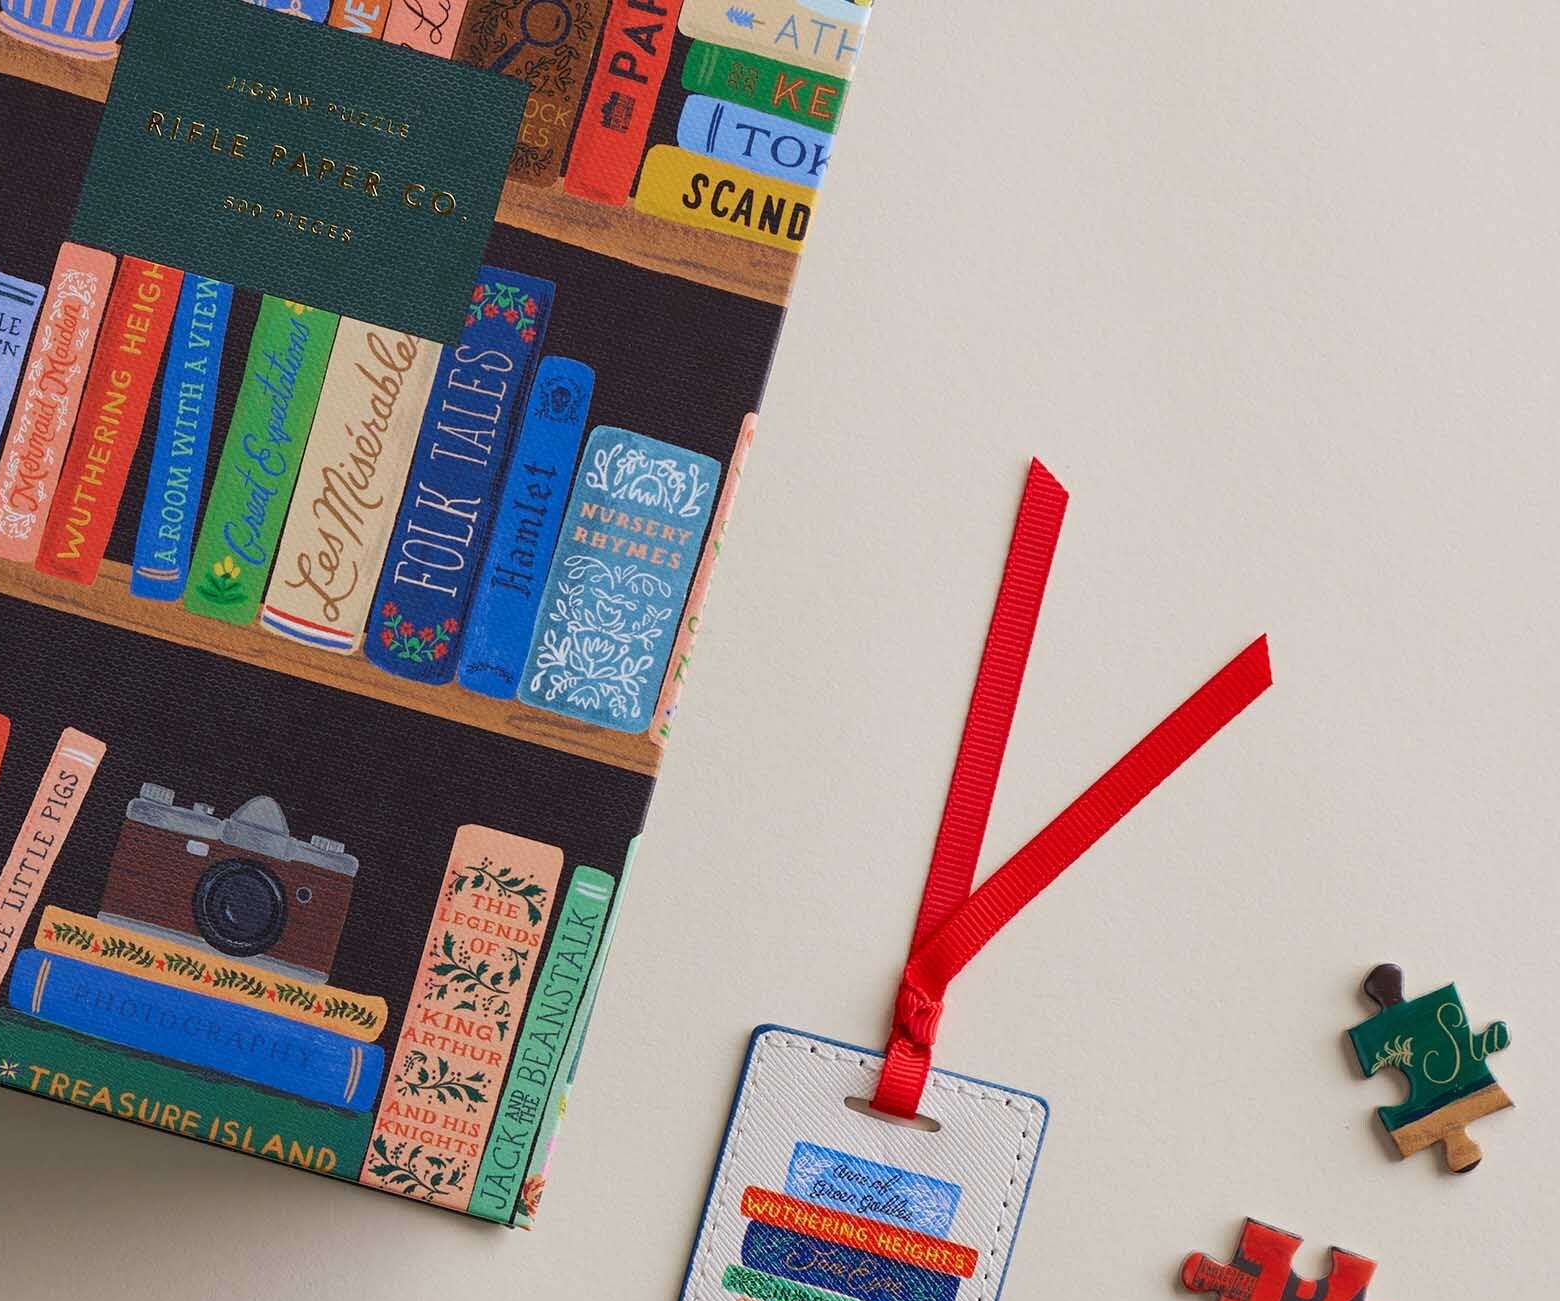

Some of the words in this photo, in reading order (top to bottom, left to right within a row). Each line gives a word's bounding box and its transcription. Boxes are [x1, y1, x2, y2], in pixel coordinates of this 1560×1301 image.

[226, 75, 313, 112] JIGSAW
[327, 103, 410, 139] PUZZLE
[772, 72, 837, 120] KE
[147, 110, 249, 158] RIFLE
[270, 144, 382, 198] PAPER
[403, 183, 469, 225] CO.
[222, 196, 263, 218] 500
[274, 208, 352, 242] PIECES
[682, 173, 811, 242] SCAND
[188, 275, 222, 351] VIEW
[38, 303, 82, 396] Maiden
[184, 357, 207, 376] A
[171, 381, 205, 459] WITH
[242, 317, 312, 478] Expectations
[430, 344, 514, 468] TALES
[9, 396, 58, 513] Mermaid
[57, 368, 132, 560] WUTHERING
[159, 464, 193, 542] ROOM
[223, 463, 279, 567] Great
[492, 461, 558, 599] Hamlet
[579, 501, 693, 546] NURSERY
[154, 549, 177, 566] A
[394, 481, 482, 598] FOLK
[572, 525, 681, 571] RHYMES
[285, 526, 360, 623] Les
[0, 832, 55, 913] LITTLE
[41, 770, 79, 824] PIGS
[438, 907, 541, 948] LEGENDS
[471, 893, 521, 921] THE
[470, 937, 501, 957] OF
[71, 982, 318, 1066] PHOTOGRAPHY
[421, 1006, 494, 1043] KING
[516, 908, 600, 1089] BEANSTALK
[402, 1027, 503, 1069] ARTHUR
[28, 1065, 203, 1138] TREASURE
[208, 1115, 338, 1174] ISLAND
[377, 1118, 480, 1158] KNIGHTS
[386, 1100, 436, 1128] AND
[441, 1115, 481, 1138] HIS
[504, 1089, 529, 1123] AND
[518, 1096, 542, 1126] THE
[480, 1129, 530, 1210] JACK
[810, 1180, 856, 1205] Green
[747, 1199, 868, 1242] WUTHERING
[878, 1235, 965, 1269] HEIGHTS
[774, 1285, 792, 1300] IN
